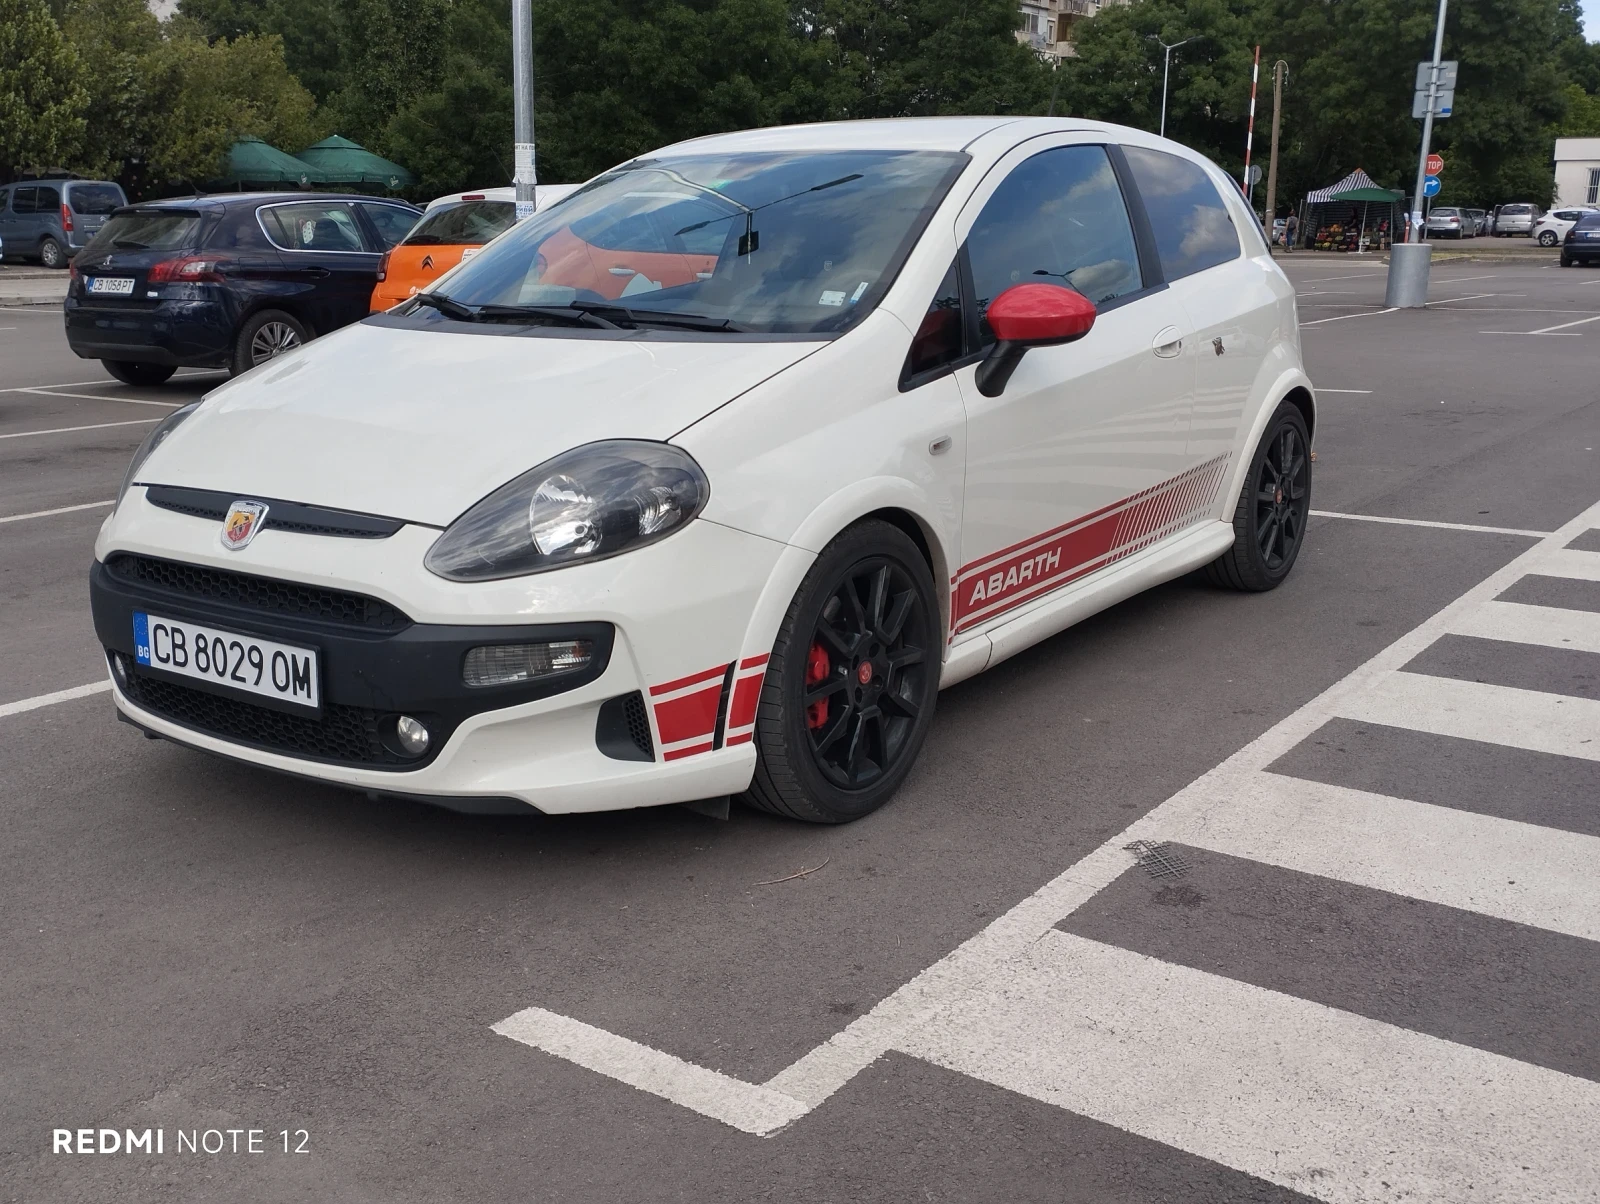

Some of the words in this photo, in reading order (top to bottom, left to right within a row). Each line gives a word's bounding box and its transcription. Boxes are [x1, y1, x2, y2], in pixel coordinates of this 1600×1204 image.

[1427, 161, 1442, 170] TOP
[93, 279, 104, 291] CB
[104, 280, 122, 291] 1058
[121, 280, 133, 292] PT
[968, 546, 1062, 607] ABARTH
[138, 645, 150, 659] BG
[153, 623, 189, 668] CB
[194, 633, 264, 686] 8029
[271, 651, 312, 699] OM
